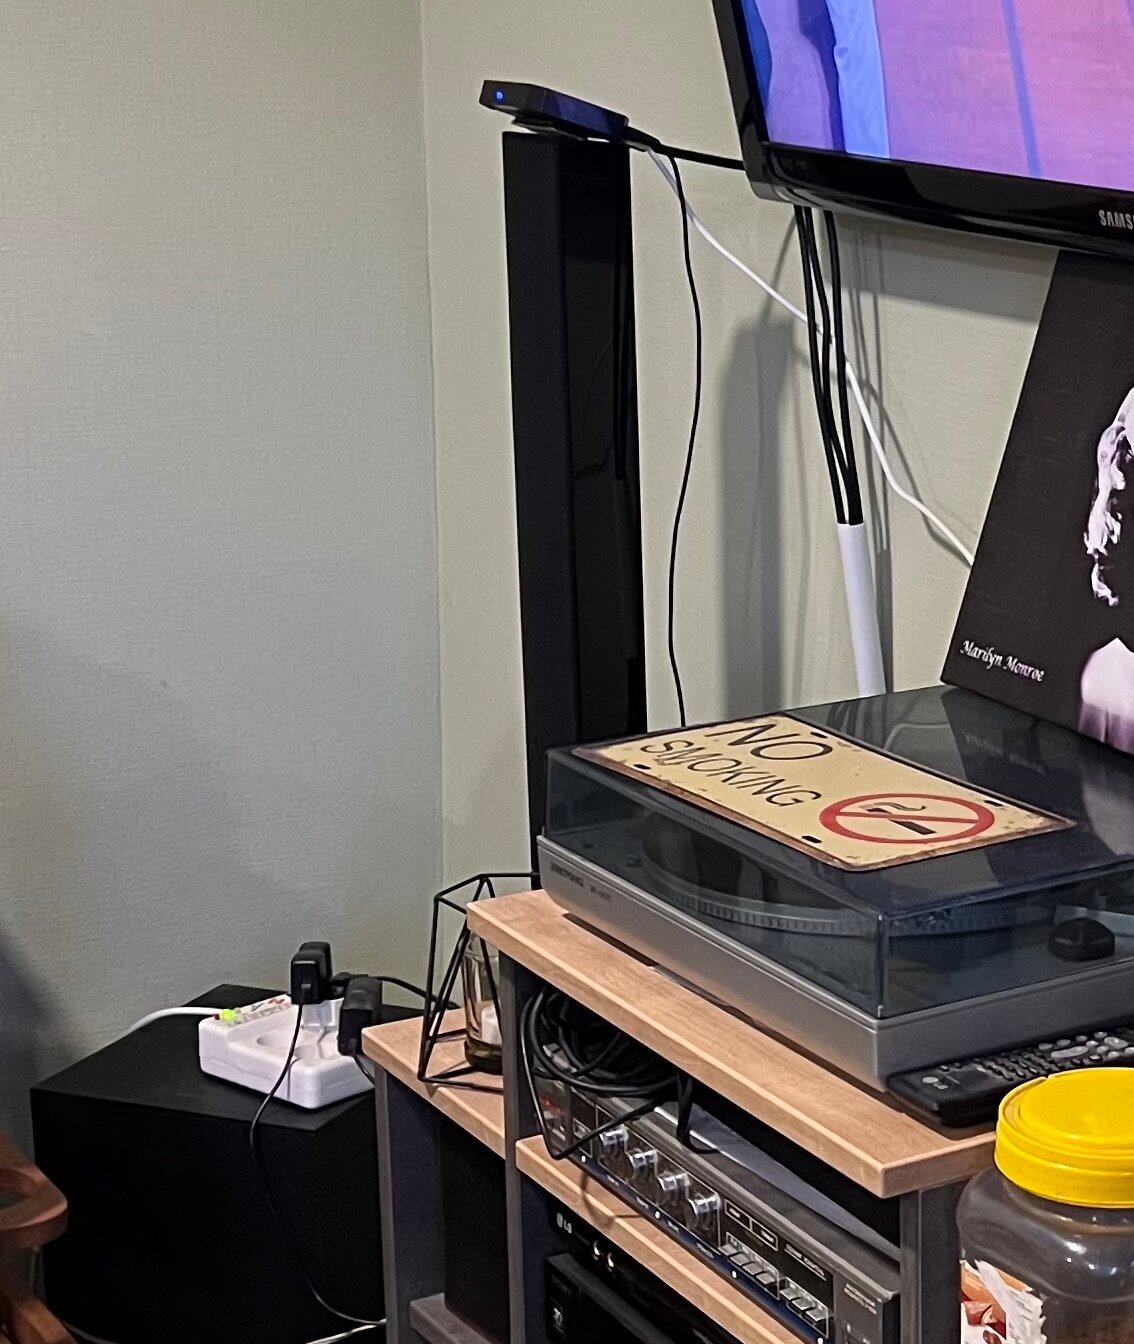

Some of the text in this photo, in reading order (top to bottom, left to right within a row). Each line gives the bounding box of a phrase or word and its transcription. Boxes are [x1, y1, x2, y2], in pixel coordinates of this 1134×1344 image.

[960, 640, 1045, 682] Marilyn Monroe
[704, 722, 833, 762] NO
[640, 739, 822, 808] SMOKING
